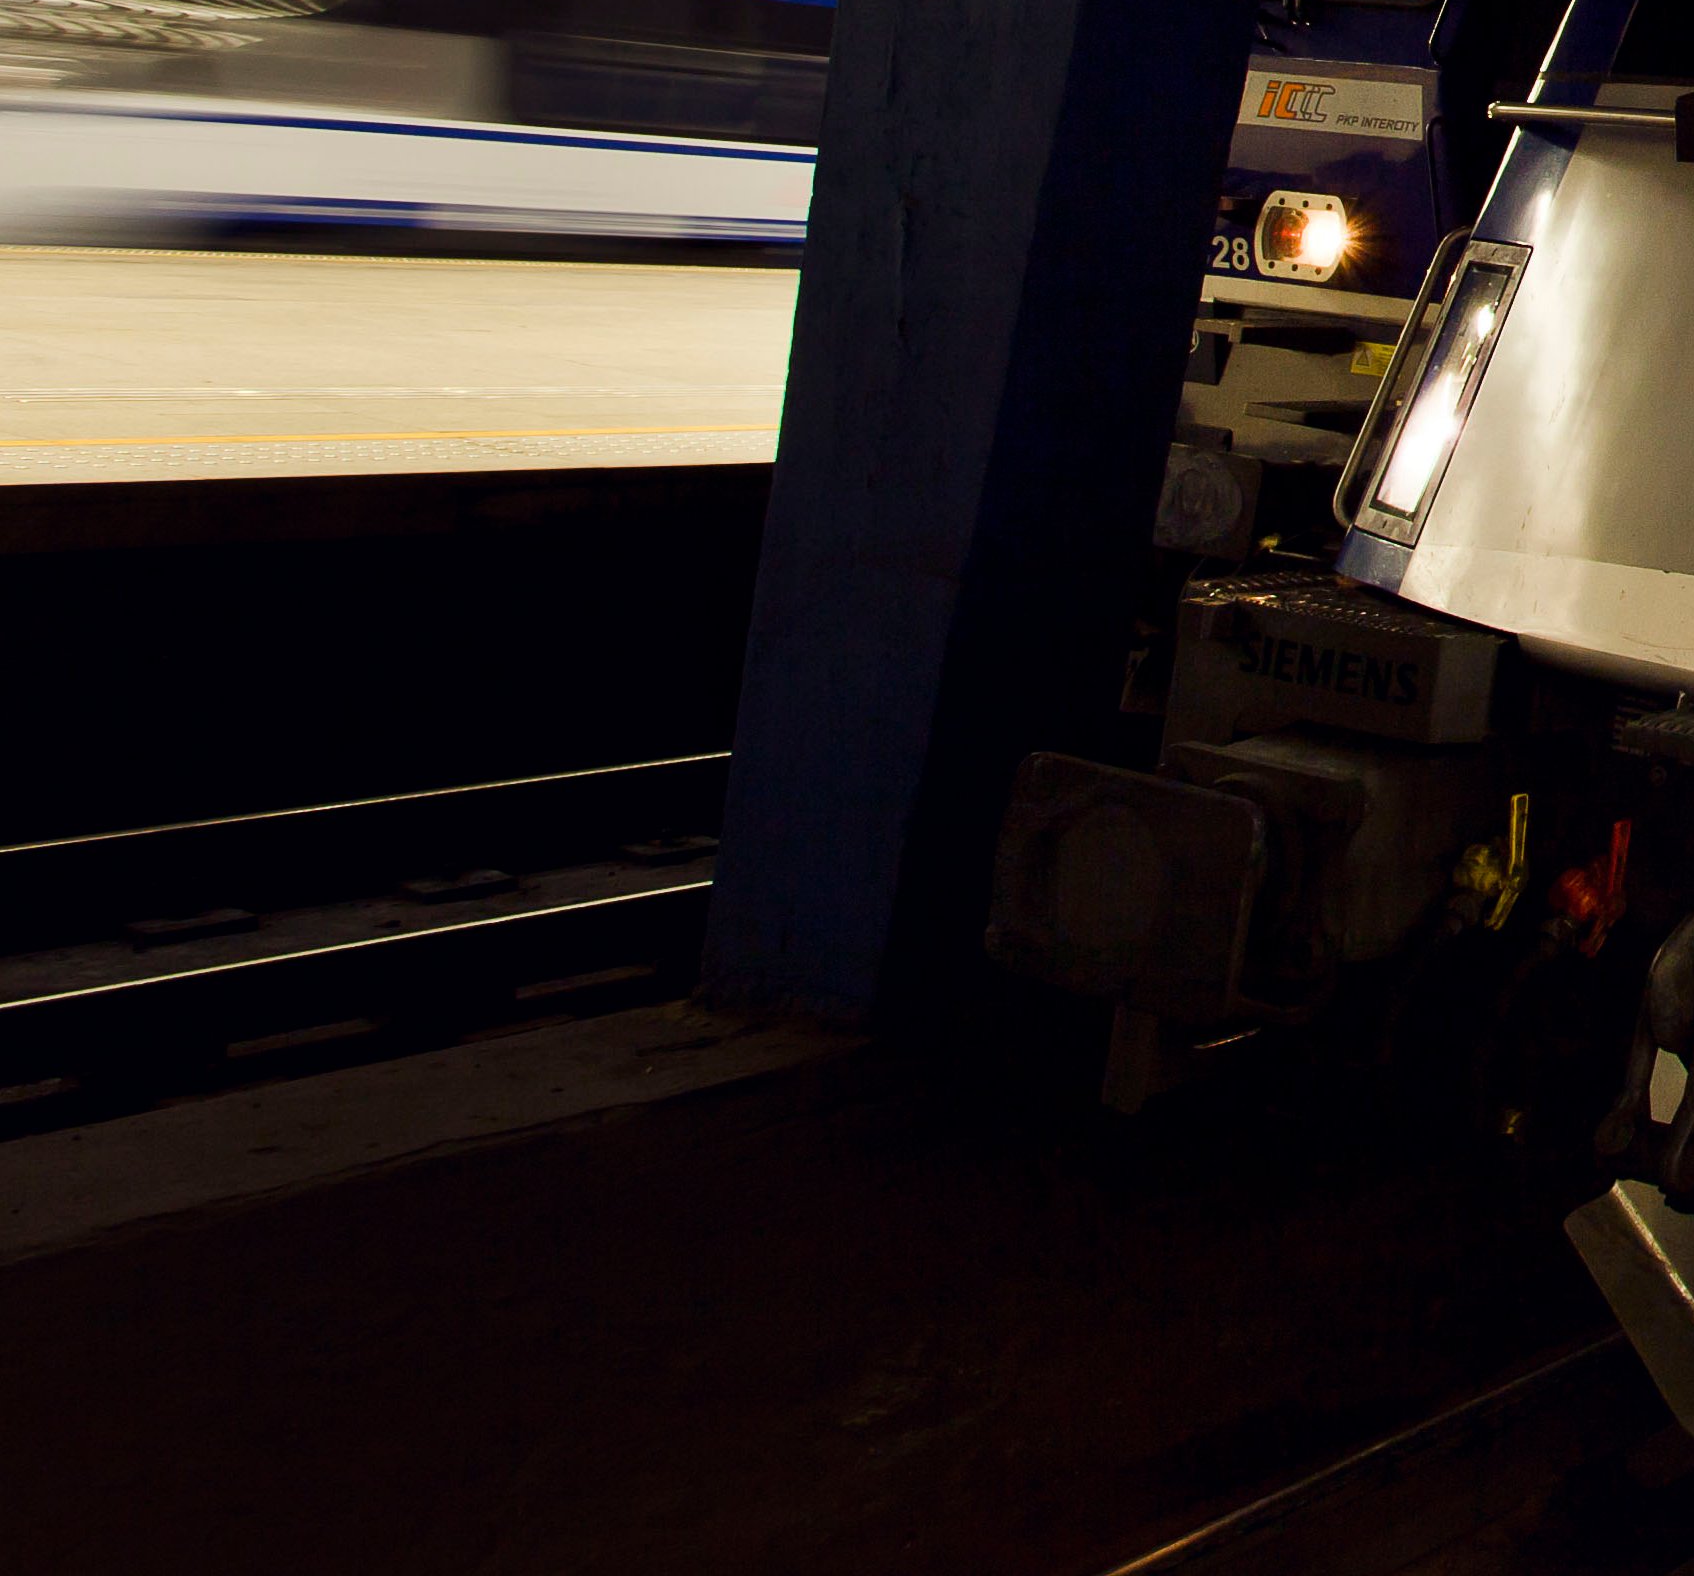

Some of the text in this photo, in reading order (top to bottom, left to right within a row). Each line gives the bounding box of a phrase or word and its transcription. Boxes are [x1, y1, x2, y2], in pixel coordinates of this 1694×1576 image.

[1336, 114, 1421, 132] PKP INTERCITY
[1239, 631, 1420, 707] SIEMENS
